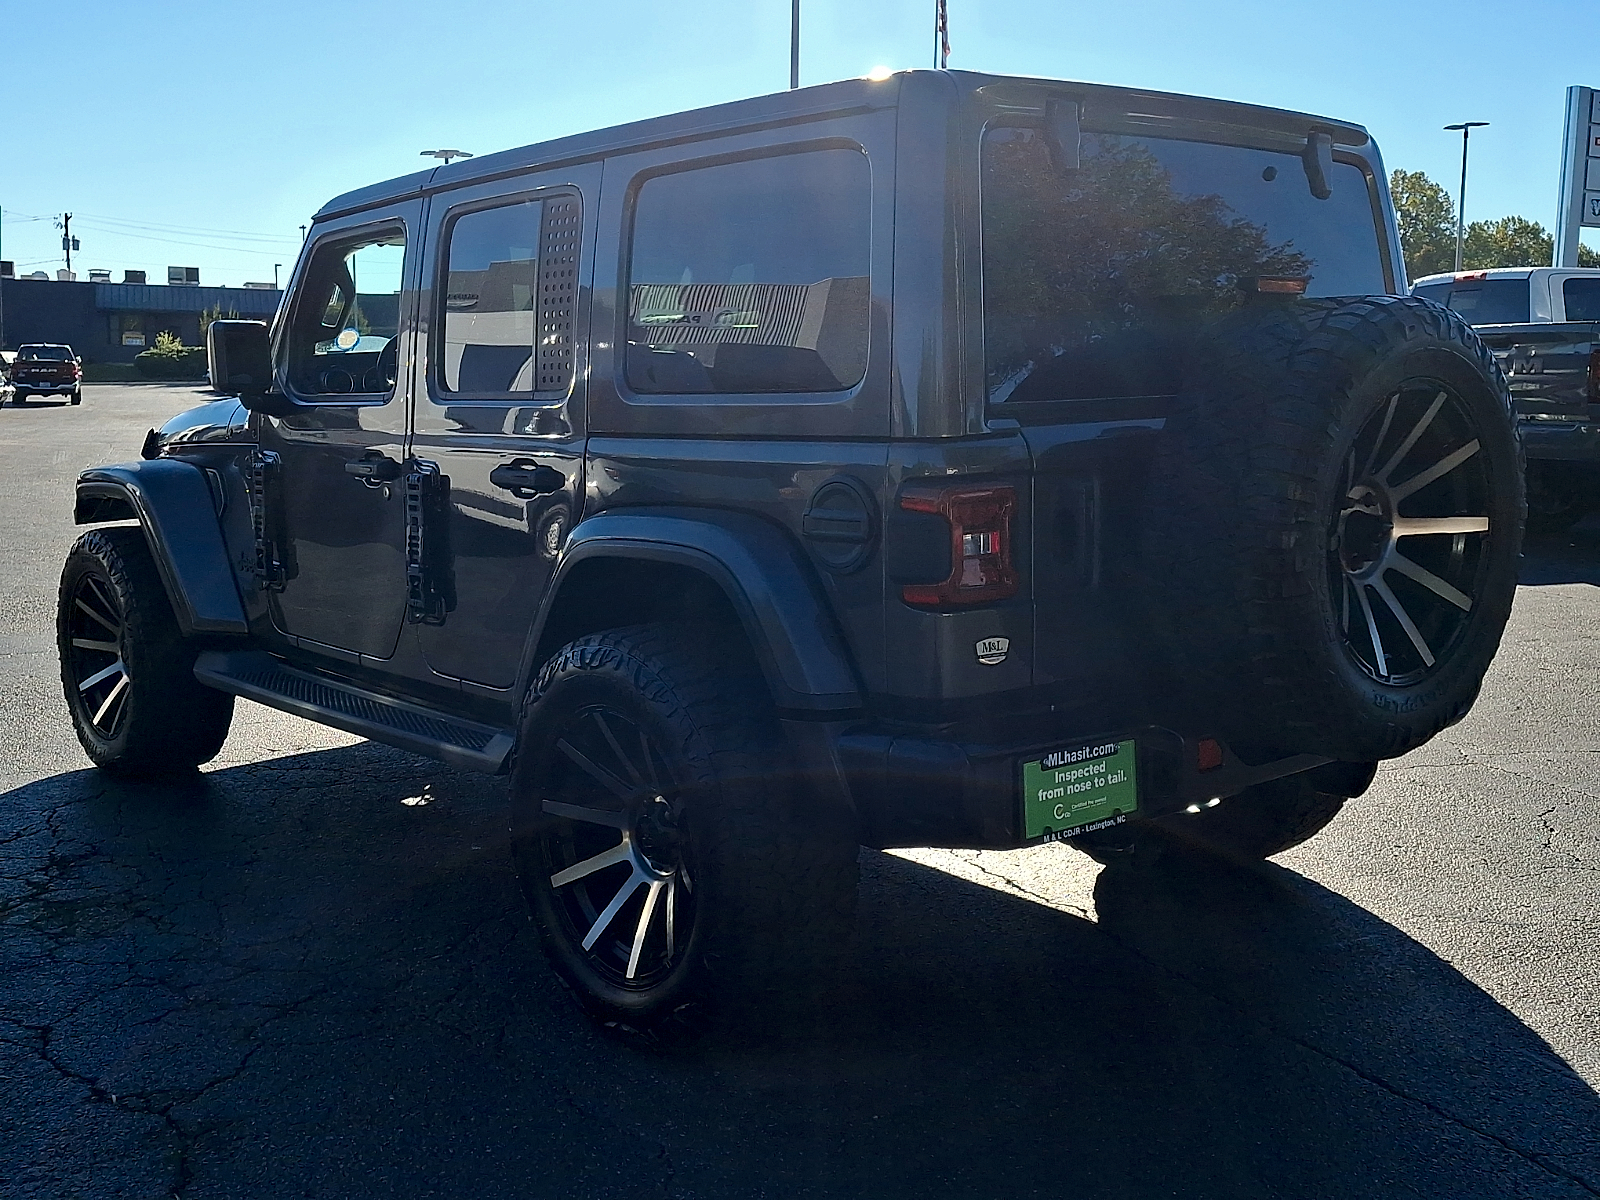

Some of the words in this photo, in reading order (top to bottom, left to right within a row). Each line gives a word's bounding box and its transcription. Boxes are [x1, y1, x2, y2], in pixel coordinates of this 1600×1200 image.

[982, 640, 1004, 653] M&L
[1048, 743, 1114, 767] MLhasit.com
[1055, 761, 1106, 783] Inspected
[1038, 787, 1065, 801] from
[1067, 781, 1092, 794] nose
[1094, 776, 1105, 788] to
[1107, 770, 1127, 785] tail.
[1043, 835, 1050, 843] M
[1051, 833, 1057, 841] &
[1057, 832, 1062, 840] L
[1063, 827, 1081, 838] CDJR
[1085, 818, 1116, 832] Lexington,
[1117, 815, 1126, 824] NC
